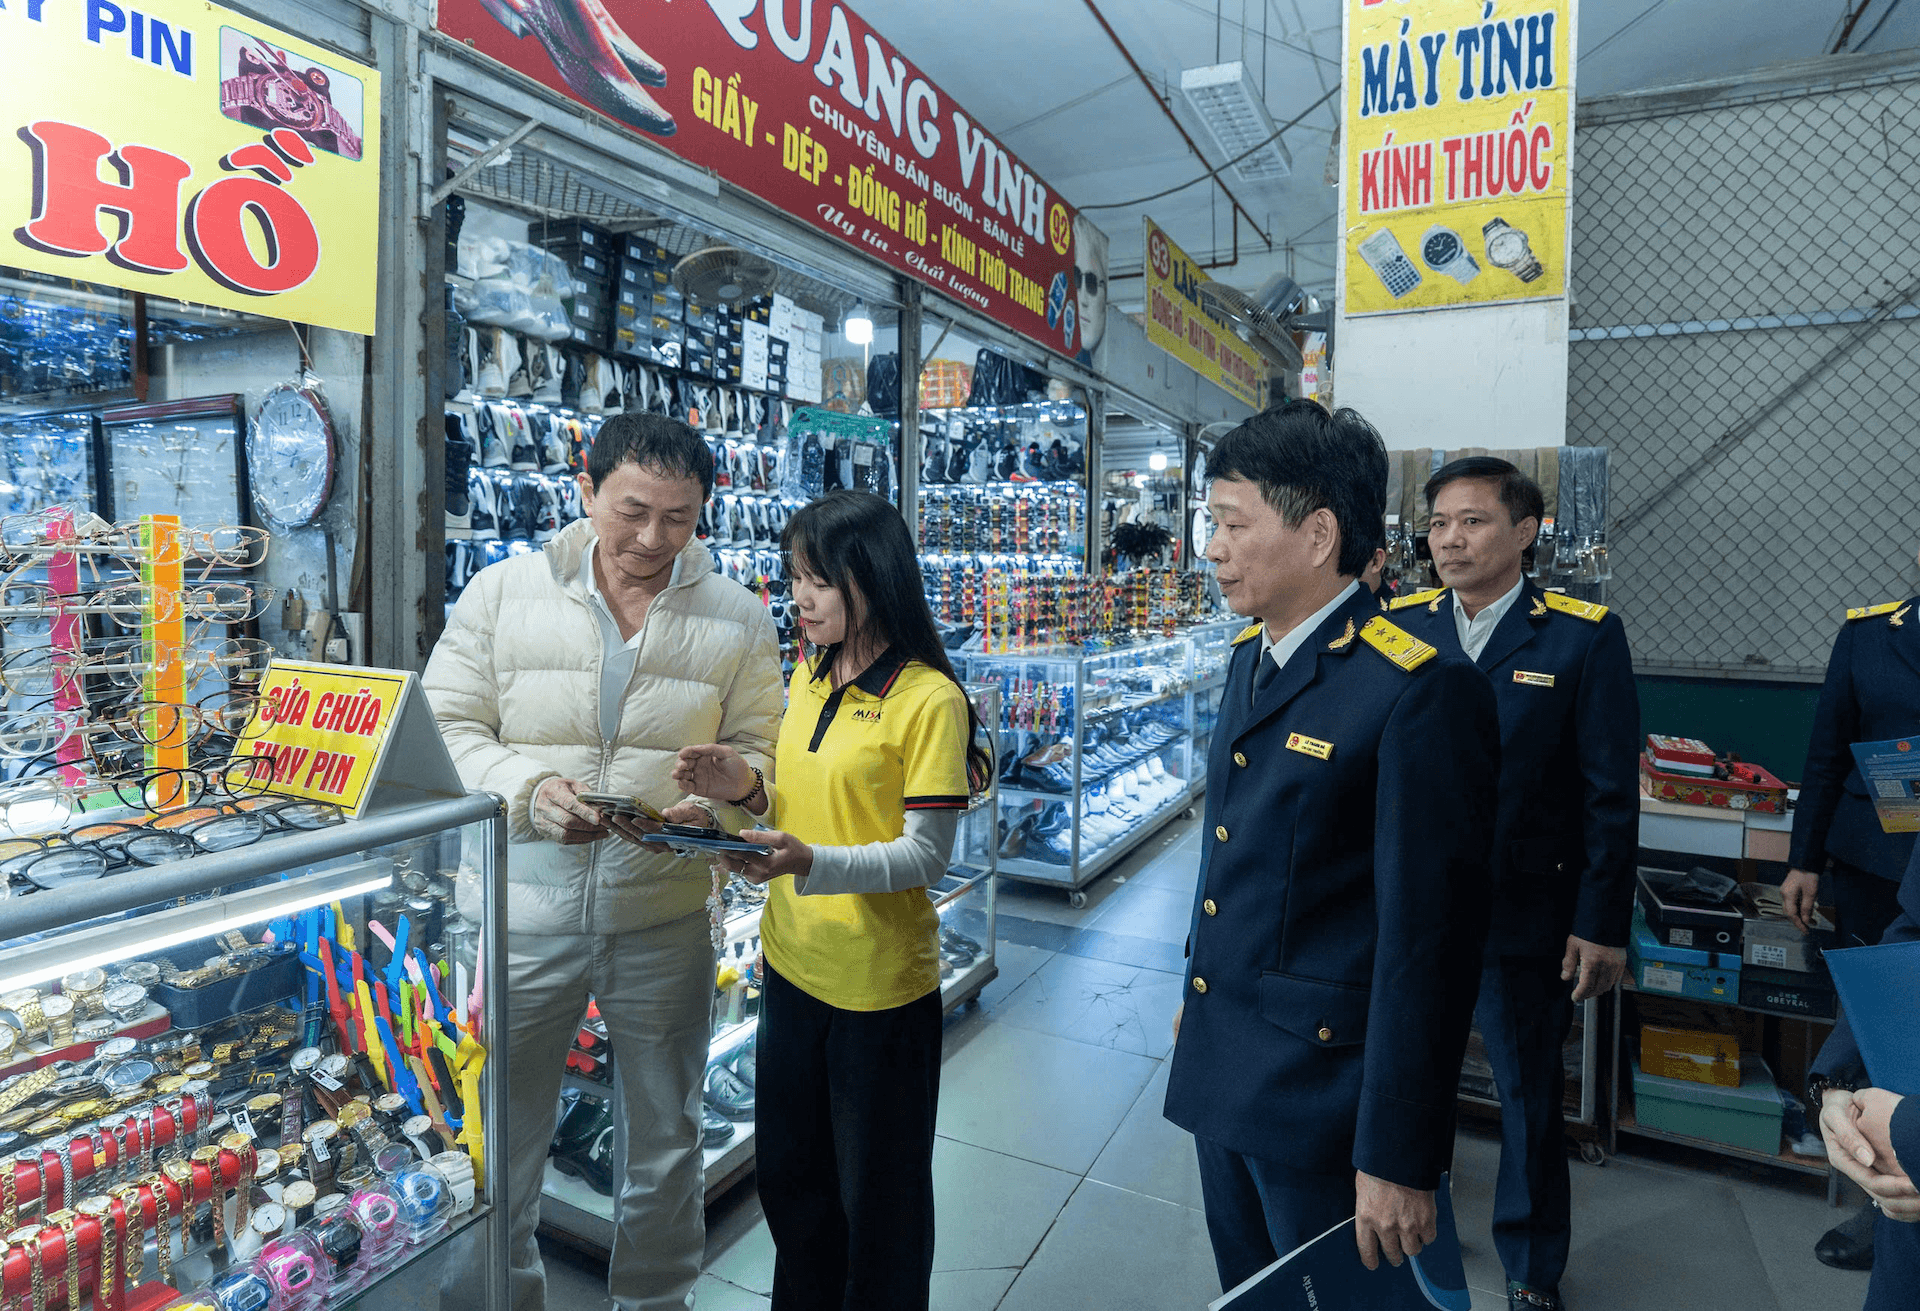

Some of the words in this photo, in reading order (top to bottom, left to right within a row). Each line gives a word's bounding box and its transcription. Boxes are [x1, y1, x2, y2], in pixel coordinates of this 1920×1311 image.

[87, 0, 192, 77] PIN
[1361, 19, 1446, 117] MÁY
[1456, 1, 1554, 99] TÍNH
[14, 121, 320, 296] HỒ
[693, 66, 758, 147] GIẦY
[783, 126, 828, 186] DÉP
[848, 163, 900, 232] ĐỒNG
[904, 198, 927, 247] HỒ
[941, 223, 976, 276] KÍNH
[979, 247, 1006, 294] THỜI
[1009, 267, 1044, 316] TRANG
[809, 95, 890, 166] CHUYÊN
[895, 159, 929, 192] BÁN
[933, 181, 973, 222] BUÔN
[983, 216, 1008, 248] BÁN
[1011, 236, 1024, 257] LẺ
[952, 111, 1047, 245] VINH
[1361, 133, 1432, 212] KÍNH
[1443, 102, 1552, 200] THUỐC
[817, 203, 857, 237] Uy
[862, 227, 888, 252] tín
[905, 251, 945, 281] Chất
[949, 273, 989, 308] lượng
[1052, 207, 1068, 250] 92
[1151, 234, 1168, 275] 93
[261, 678, 310, 726] SỬA
[312, 687, 382, 736] CHỮA
[244, 741, 309, 785] THAY
[304, 751, 356, 795] PIN
